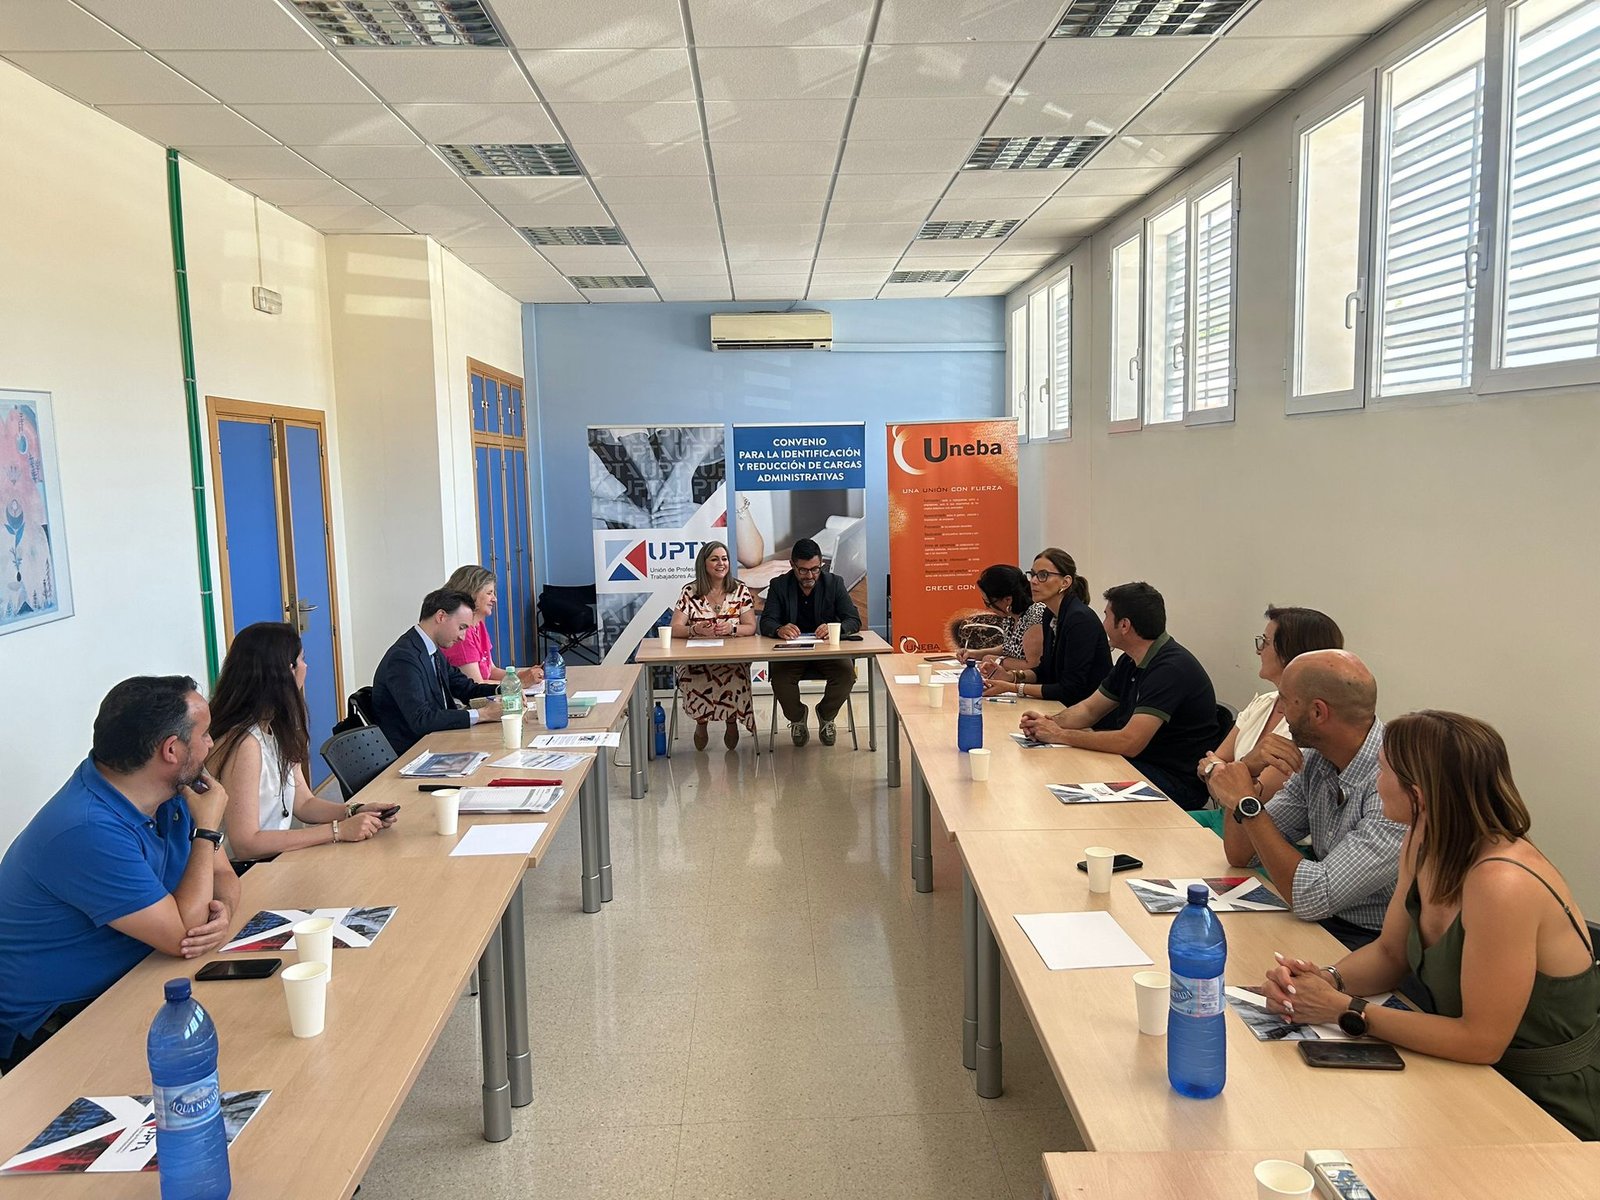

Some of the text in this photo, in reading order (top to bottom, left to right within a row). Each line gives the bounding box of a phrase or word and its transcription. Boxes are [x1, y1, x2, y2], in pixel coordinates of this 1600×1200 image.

[773, 437, 827, 447] CONVENIO
[739, 446, 861, 459] PARA LA IDENTIFICACIÓN
[923, 437, 1002, 463] Uneba
[738, 460, 862, 471] Y REDUCCIÓN DE CARGAS
[757, 472, 844, 482] ADMINISTRATIVAS
[648, 541, 706, 560] UPT
[171, 1101, 195, 1116] AQUA
